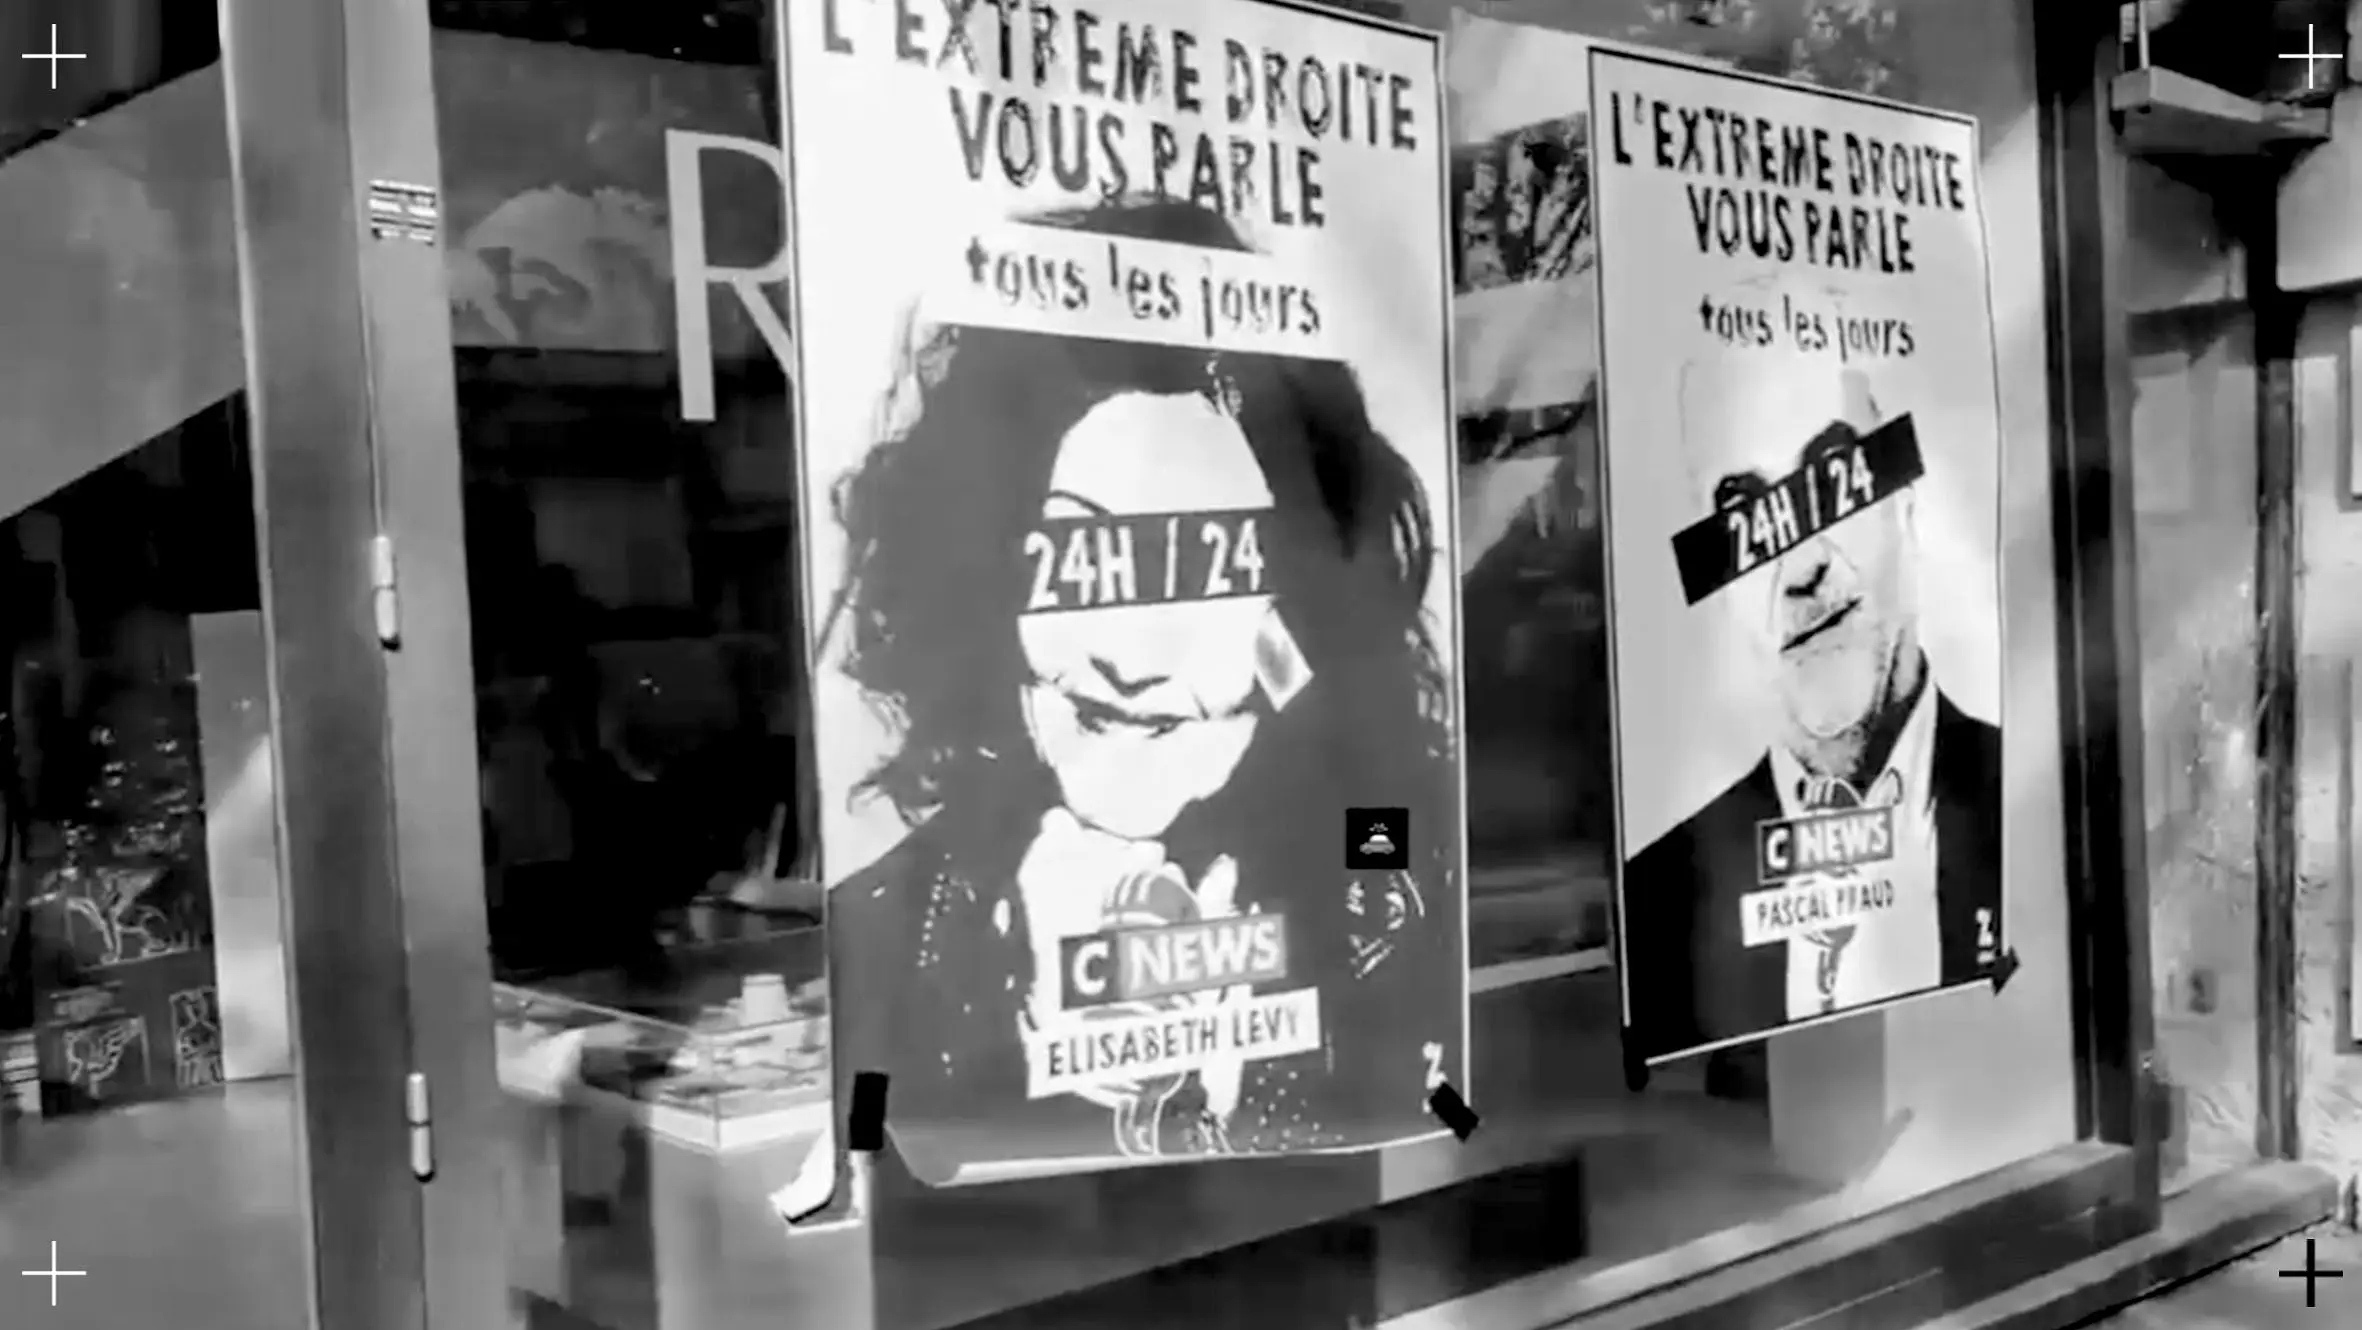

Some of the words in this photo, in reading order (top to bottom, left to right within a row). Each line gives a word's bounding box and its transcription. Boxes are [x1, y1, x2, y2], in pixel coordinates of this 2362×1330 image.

[822, 0, 1202, 114] LEXTREME
[1223, 38, 1418, 150] DROITE
[948, 86, 1128, 198] VOUS
[1152, 120, 1326, 227] PARLE
[1610, 91, 1833, 193] L'EXTREME
[1842, 132, 1966, 211] DROITE
[1686, 183, 1795, 263] VOUS
[1804, 199, 1916, 274] PARLE
[965, 235, 1089, 309] tous
[1107, 241, 1182, 319] les
[1201, 256, 1322, 339] jours
[1700, 294, 1774, 347] tous
[1782, 294, 1829, 352] les
[1835, 300, 1916, 364] jours
[1728, 484, 1800, 573] 24H
[1828, 444, 1875, 519] 24
[1023, 525, 1137, 611] 24H
[1200, 517, 1265, 597] 24
[1765, 826, 1790, 871] C
[1799, 812, 1890, 864] NEWS
[1756, 887, 1831, 931] PASCAL
[1072, 941, 1110, 995] C
[1129, 920, 1278, 991] NEWS
[1048, 1016, 1218, 1077] ELISABETH
[1232, 1004, 1300, 1048] LEVY
